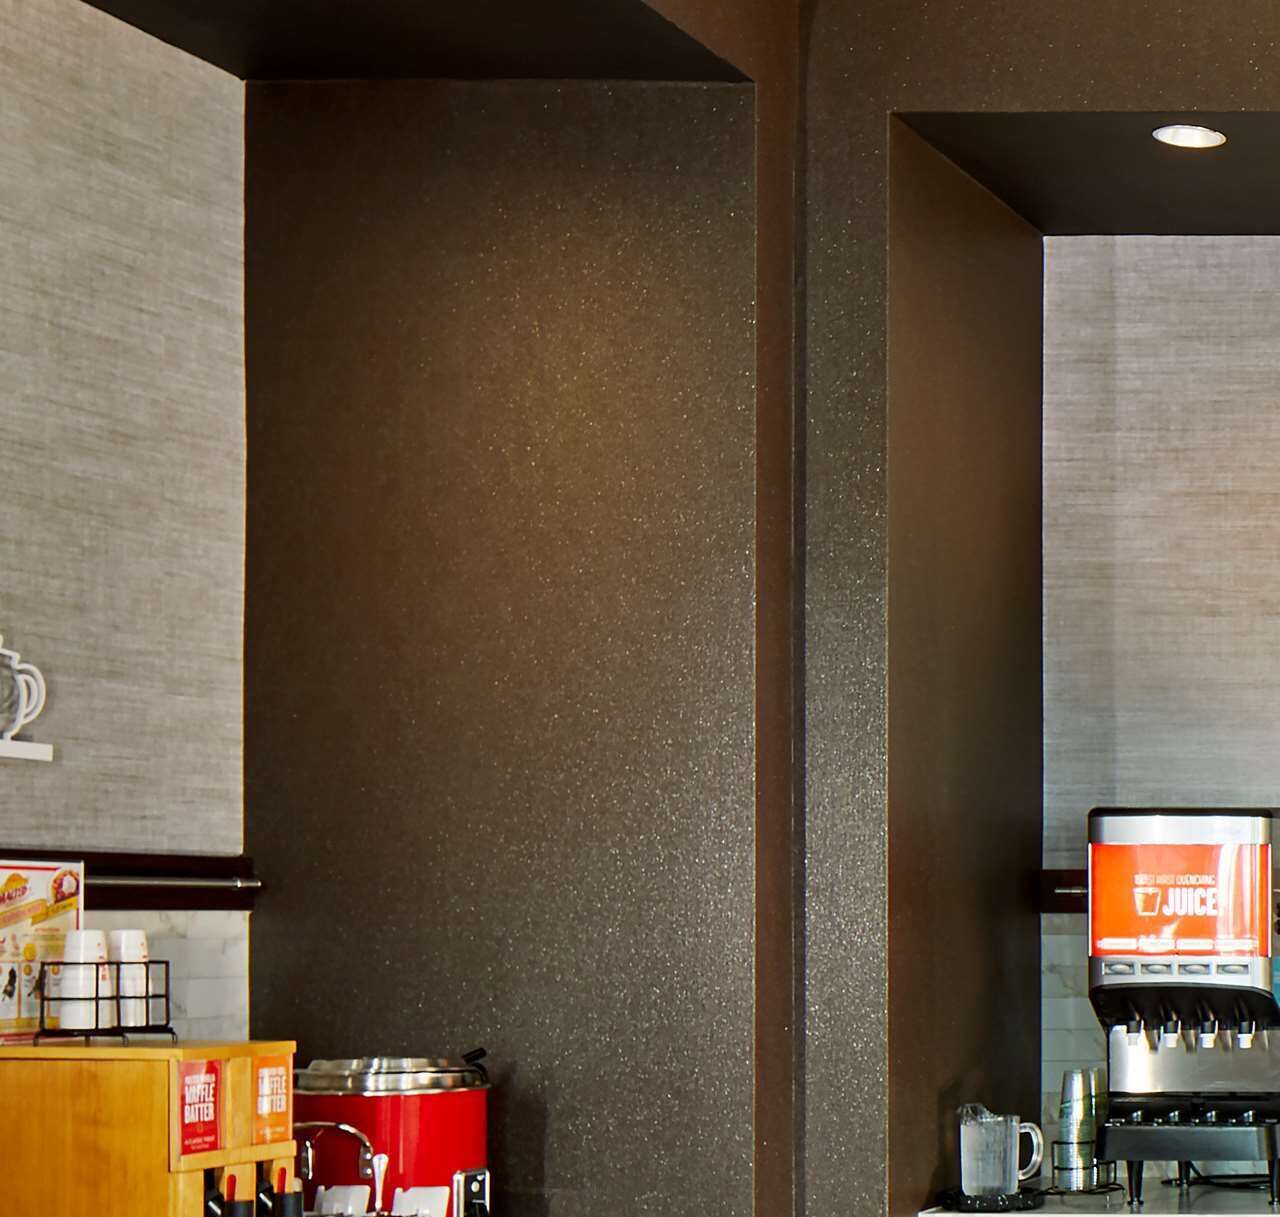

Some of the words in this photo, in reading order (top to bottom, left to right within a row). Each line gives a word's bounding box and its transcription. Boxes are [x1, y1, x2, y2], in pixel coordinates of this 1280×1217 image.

[1162, 886, 1218, 917] JUICE
[184, 1082, 216, 1105] WAFFLE
[183, 1103, 215, 1125] BATTER
